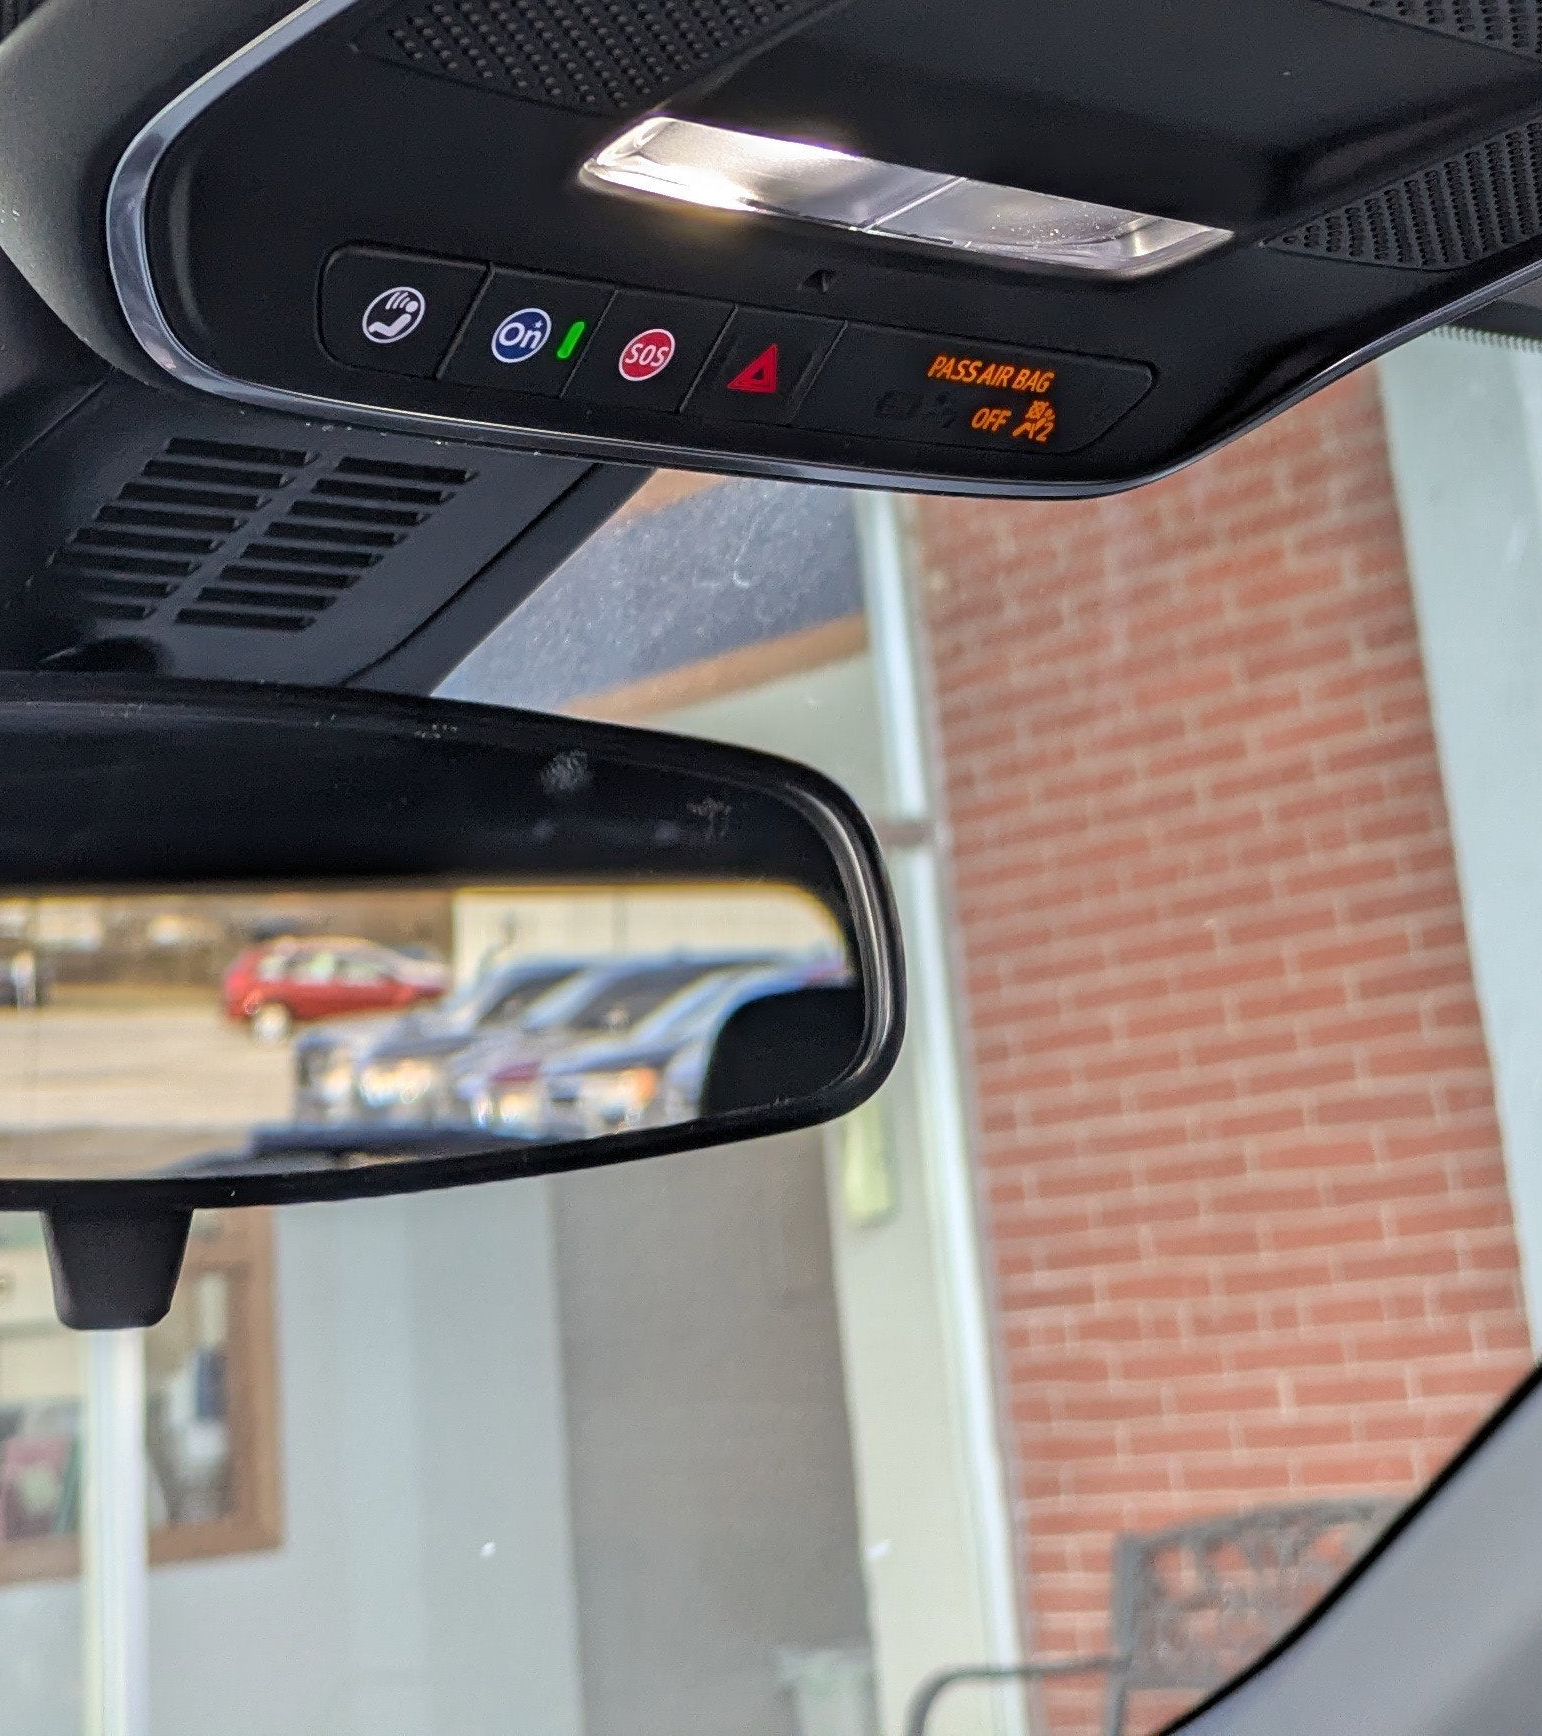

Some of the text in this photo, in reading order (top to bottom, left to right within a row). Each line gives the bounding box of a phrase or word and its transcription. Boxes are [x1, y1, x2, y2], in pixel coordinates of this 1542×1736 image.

[498, 321, 542, 349] On
[624, 343, 669, 368] SOS
[926, 355, 1055, 393] PASS AIR BAG
[970, 407, 1012, 432] OFF
